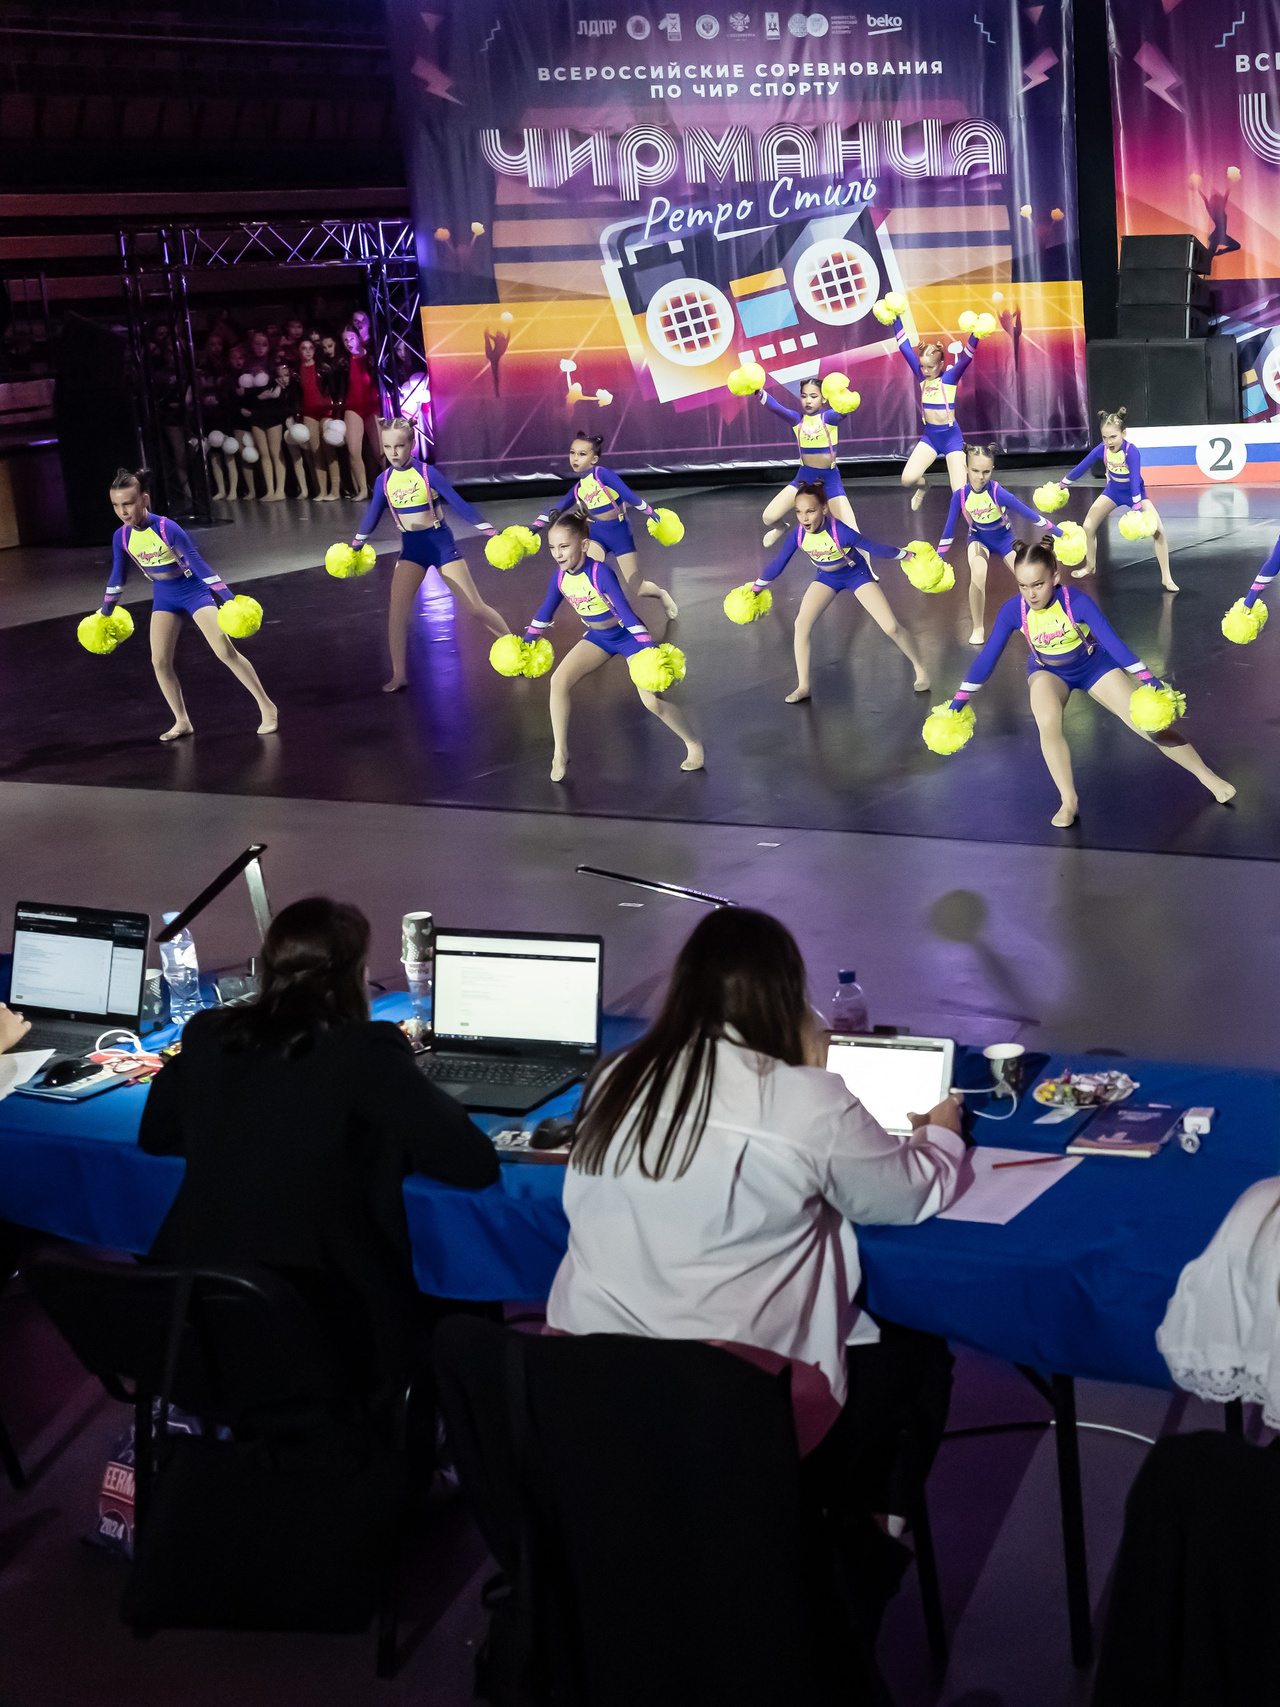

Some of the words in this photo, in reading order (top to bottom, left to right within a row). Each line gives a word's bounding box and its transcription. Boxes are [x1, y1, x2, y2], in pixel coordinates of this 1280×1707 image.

[577, 20, 617, 37] ЛДПР
[866, 14, 903, 27] beko
[537, 62, 745, 82] ВСЕРОССИЙСКИЕ
[755, 60, 943, 78] СОРЕВНОВАНИЯ
[650, 82, 682, 99] ПО
[696, 82, 739, 98] ЧИР
[750, 81, 840, 97] СПОРТУ
[643, 196, 754, 241] Ретро
[768, 176, 878, 219] Стиль
[1208, 437, 1234, 471] 2
[99, 1516, 126, 1541] 2024
